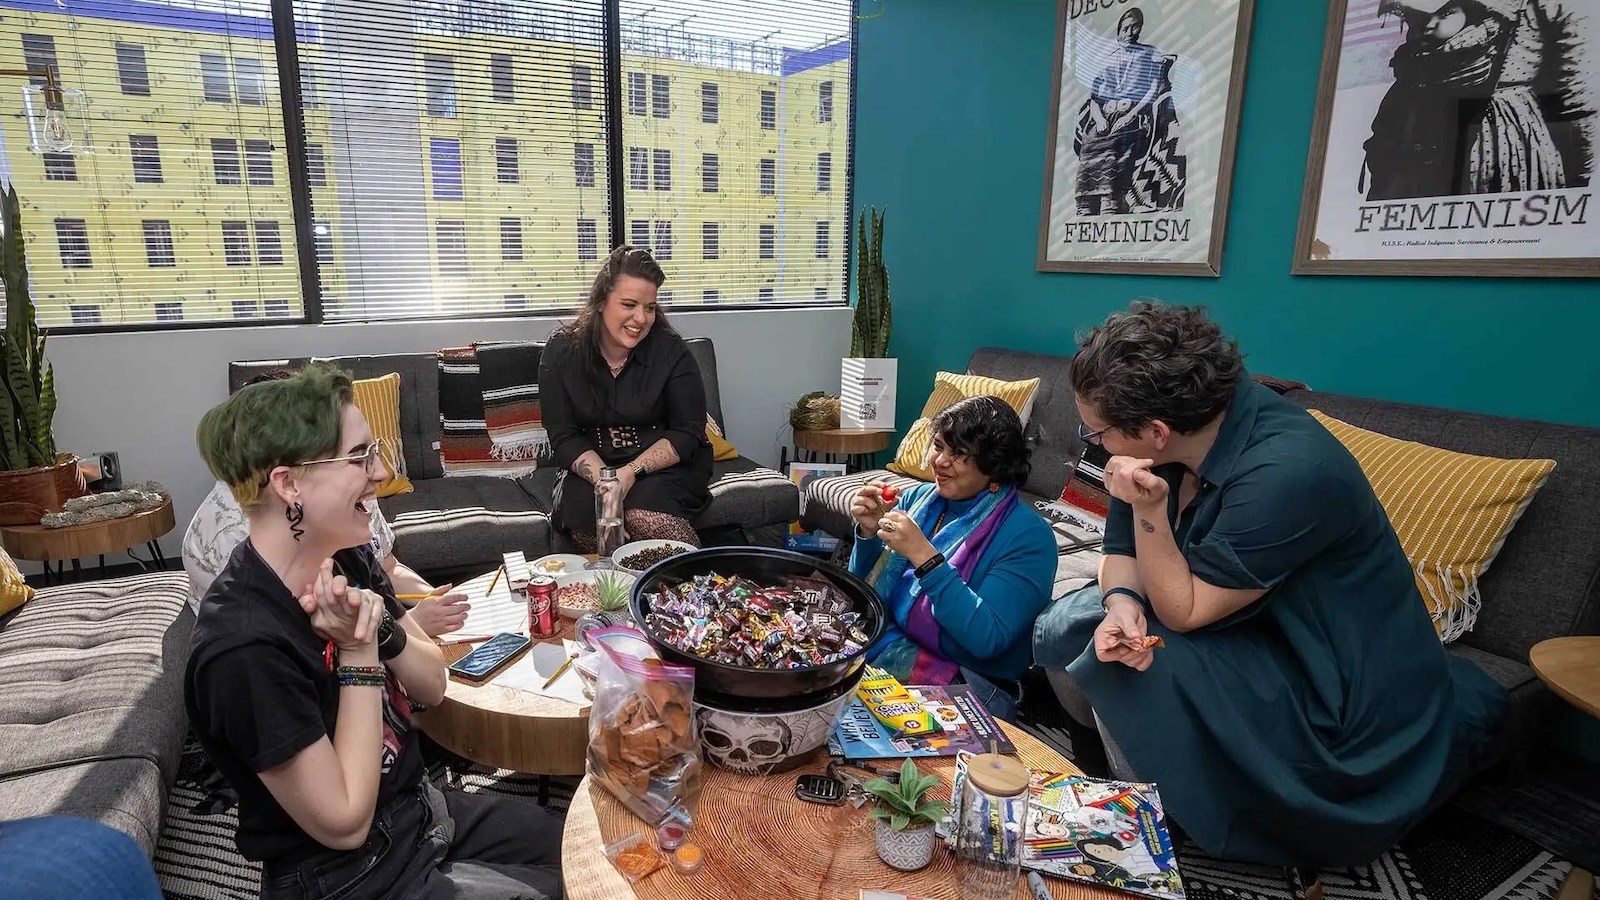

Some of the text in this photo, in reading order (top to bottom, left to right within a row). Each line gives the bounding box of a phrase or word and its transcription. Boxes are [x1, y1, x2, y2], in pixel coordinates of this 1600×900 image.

[1353, 193, 1593, 232] FEMINISM
[1063, 218, 1191, 243] FEMINISM
[840, 713, 862, 743] WHAT
[851, 702, 881, 739] BELIEVE
